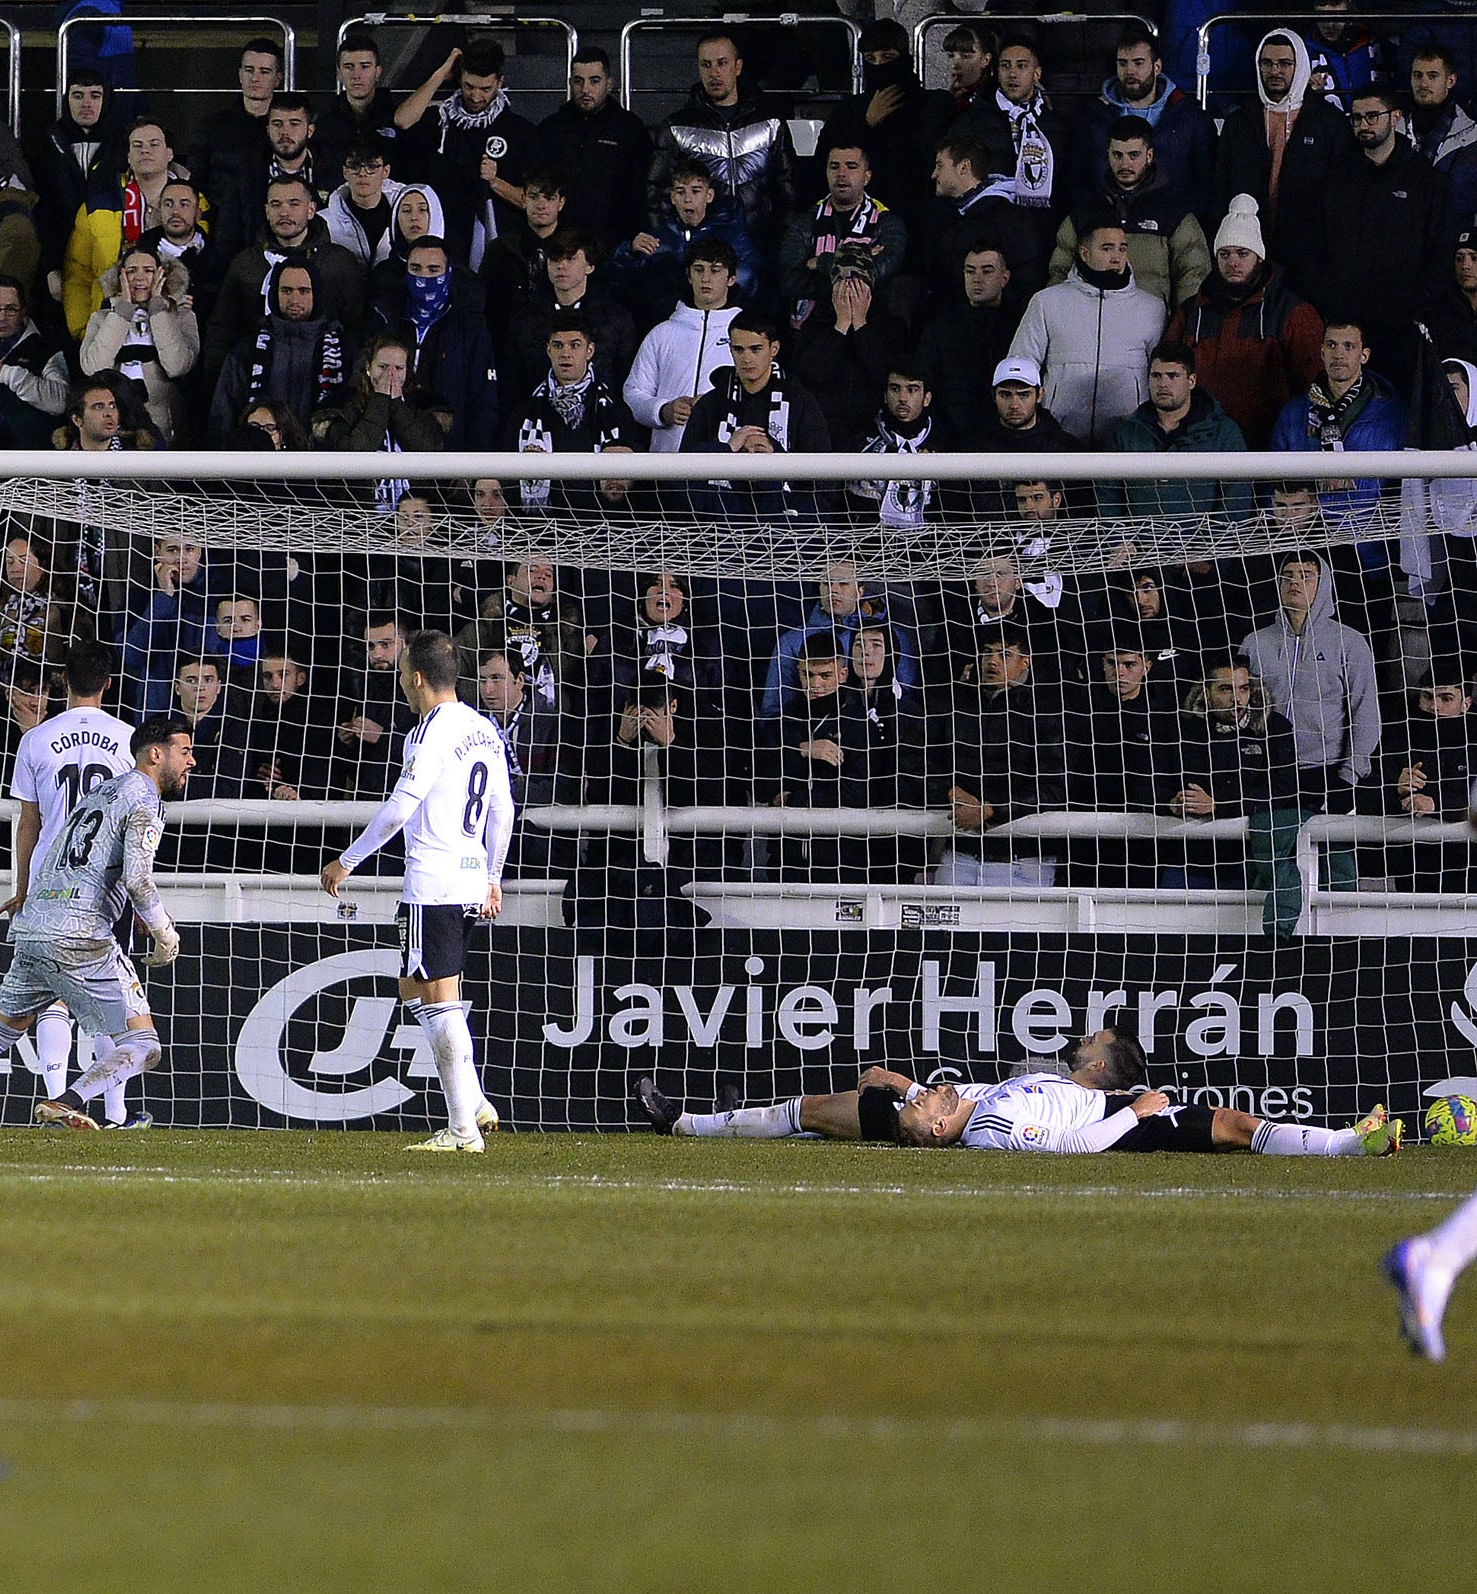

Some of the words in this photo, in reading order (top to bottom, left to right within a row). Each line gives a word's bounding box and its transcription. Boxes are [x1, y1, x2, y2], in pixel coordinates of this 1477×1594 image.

[50, 731, 119, 756] CÓRDOBA
[461, 761, 488, 838] 8
[55, 807, 105, 871] 13
[542, 955, 893, 1051] Javier
[921, 960, 1314, 1057] Herrán
[46, 1063, 62, 1073] BCF
